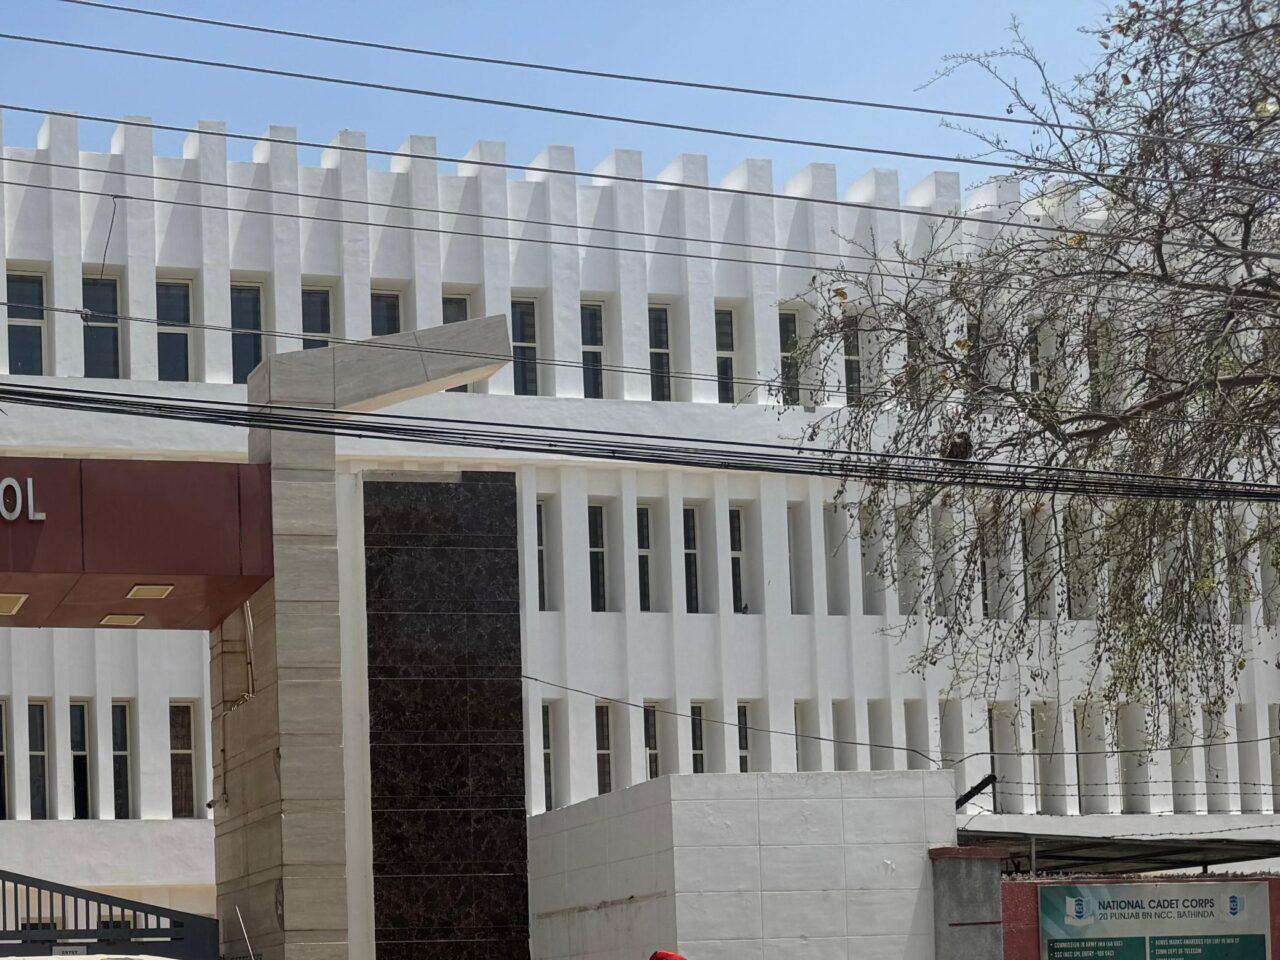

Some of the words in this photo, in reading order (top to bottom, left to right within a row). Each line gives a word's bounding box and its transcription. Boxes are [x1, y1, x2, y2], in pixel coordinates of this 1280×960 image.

[1098, 899, 1145, 910] NATIONAL
[1148, 898, 1180, 909] CADET
[1182, 898, 1215, 909] CORPS
[1099, 912, 1108, 920] 20
[1109, 912, 1140, 920] PUNJAB
[1177, 910, 1215, 919] BATHINDA
